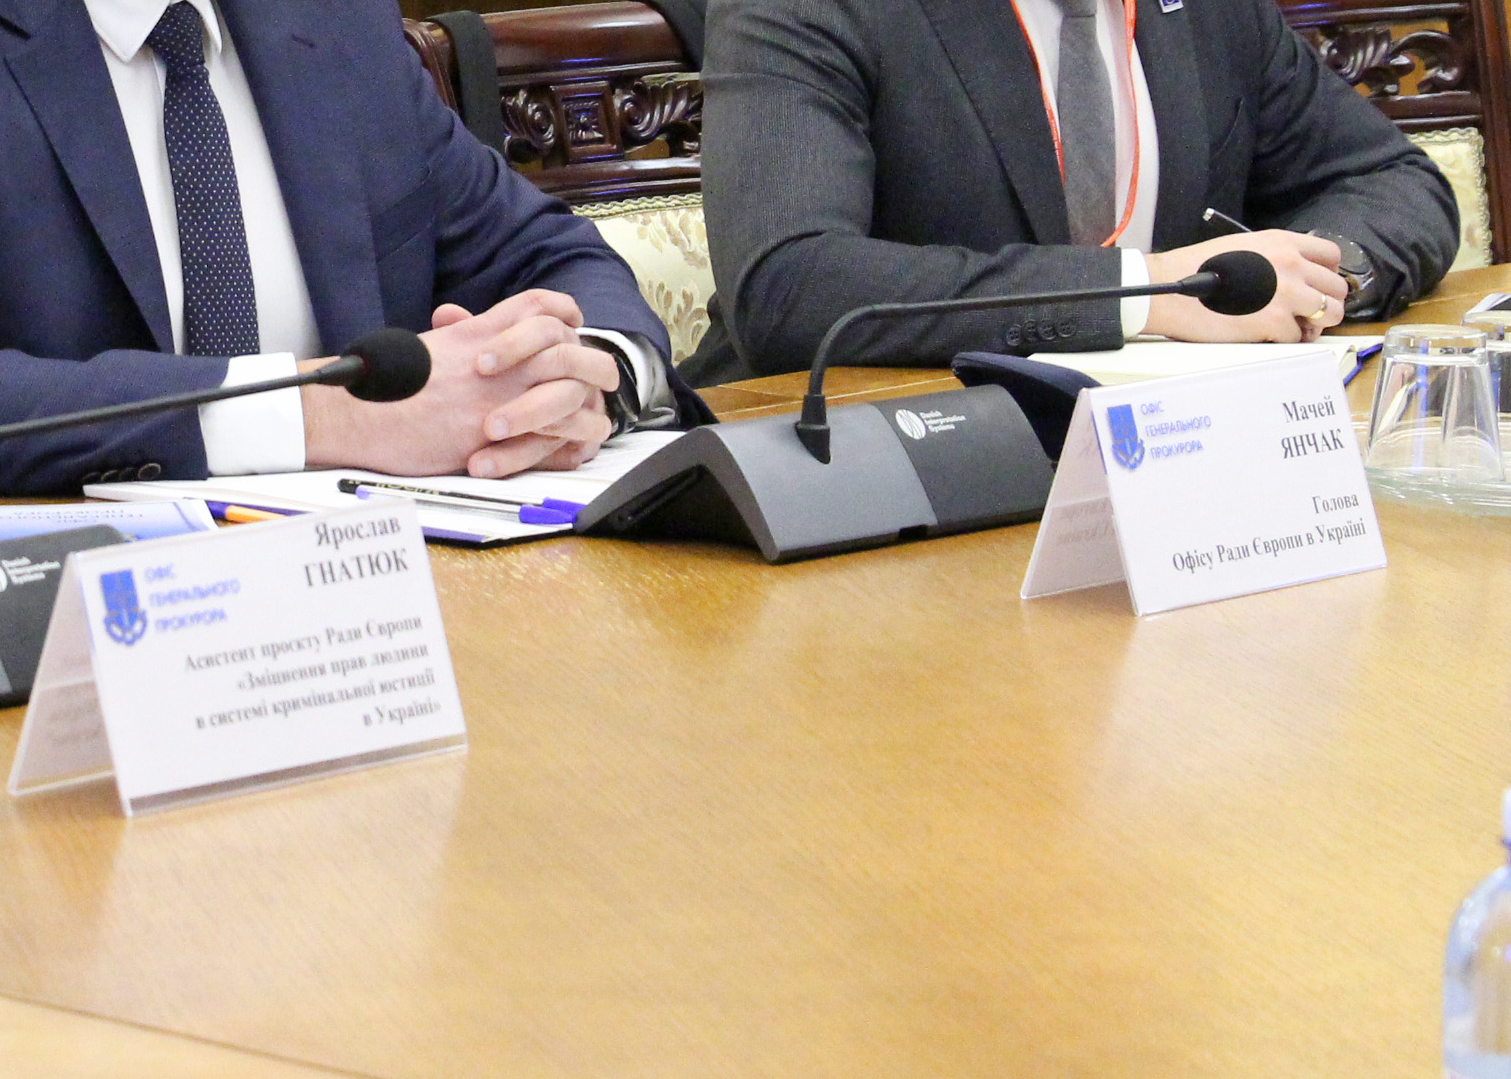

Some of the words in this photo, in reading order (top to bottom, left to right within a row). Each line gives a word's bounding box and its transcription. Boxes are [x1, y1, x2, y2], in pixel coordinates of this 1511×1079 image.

[1140, 401, 1165, 415] ОФІС
[1282, 396, 1336, 423] Мачей
[1145, 415, 1212, 436] ГЕНЕРАЛЬНОГО
[1150, 440, 1204, 458] ПРОКУРОРА
[1281, 429, 1345, 459] ЯНЧАК
[1312, 494, 1359, 514] Голова
[315, 516, 401, 547] Ярослав
[1172, 549, 1213, 574] Офісу
[1216, 544, 1250, 563] Ради
[1253, 535, 1303, 557] Європи
[1306, 532, 1315, 545] в
[1315, 517, 1366, 545] Україні
[304, 548, 409, 587] ГНАТЮК
[185, 646, 256, 672] Асистент
[325, 627, 363, 647] Ради
[366, 616, 423, 639] Європи
[331, 654, 368, 676] прав
[371, 644, 429, 667] людини
[196, 715, 206, 729] в
[209, 700, 268, 728] системі
[272, 680, 376, 718] кримінальної
[363, 712, 373, 727] в
